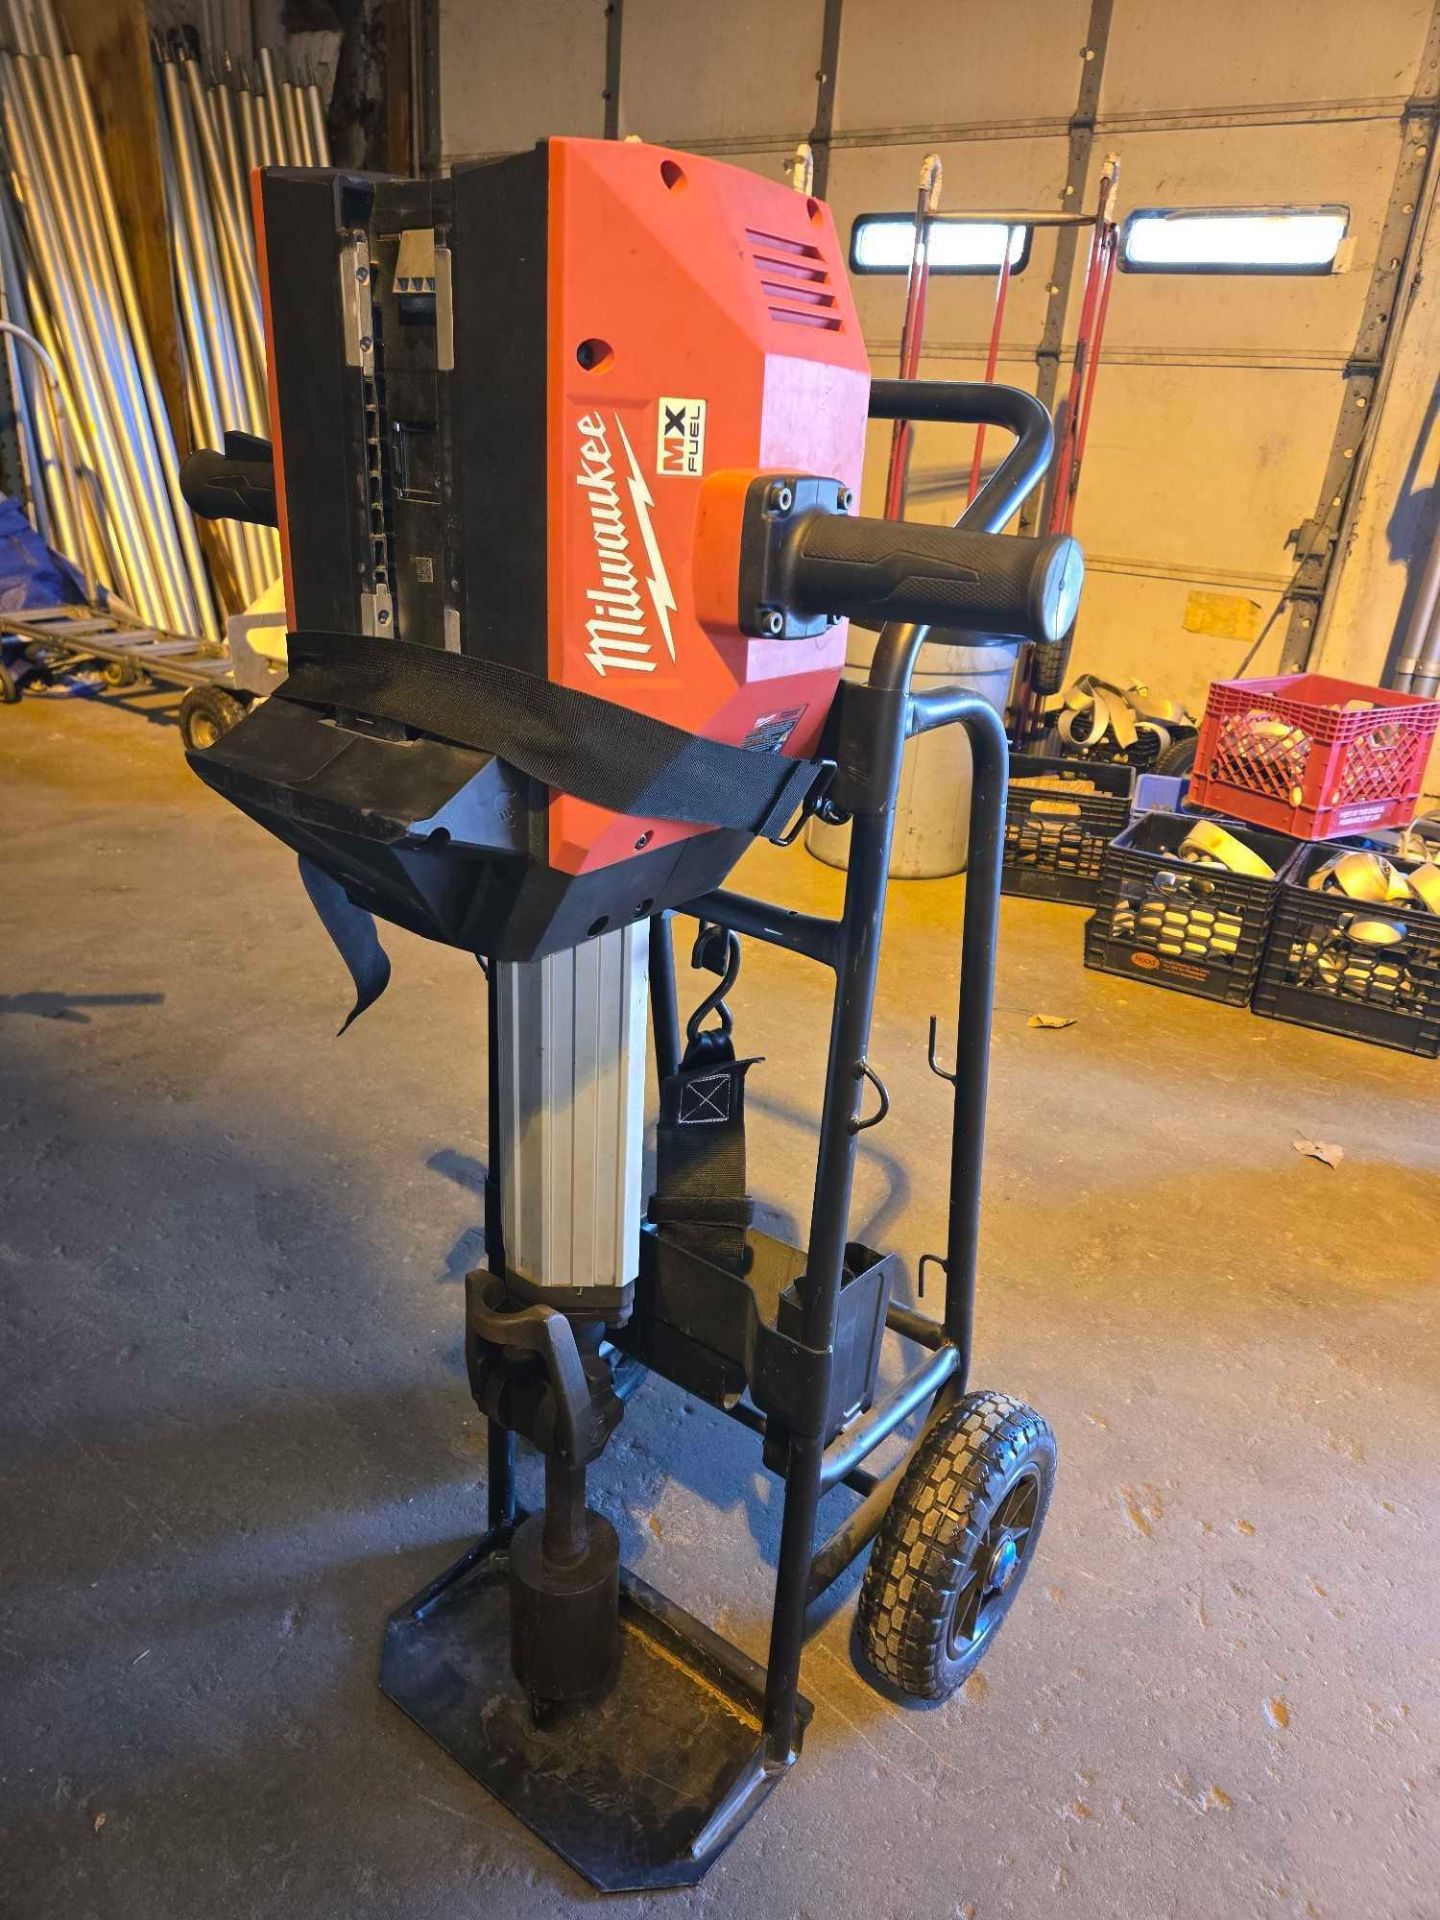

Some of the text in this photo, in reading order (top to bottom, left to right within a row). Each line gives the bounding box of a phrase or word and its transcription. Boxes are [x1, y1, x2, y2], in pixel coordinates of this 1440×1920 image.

[663, 405, 686, 471] MX
[688, 406, 701, 472] FUEL
[576, 410, 657, 676] Milwaukee
